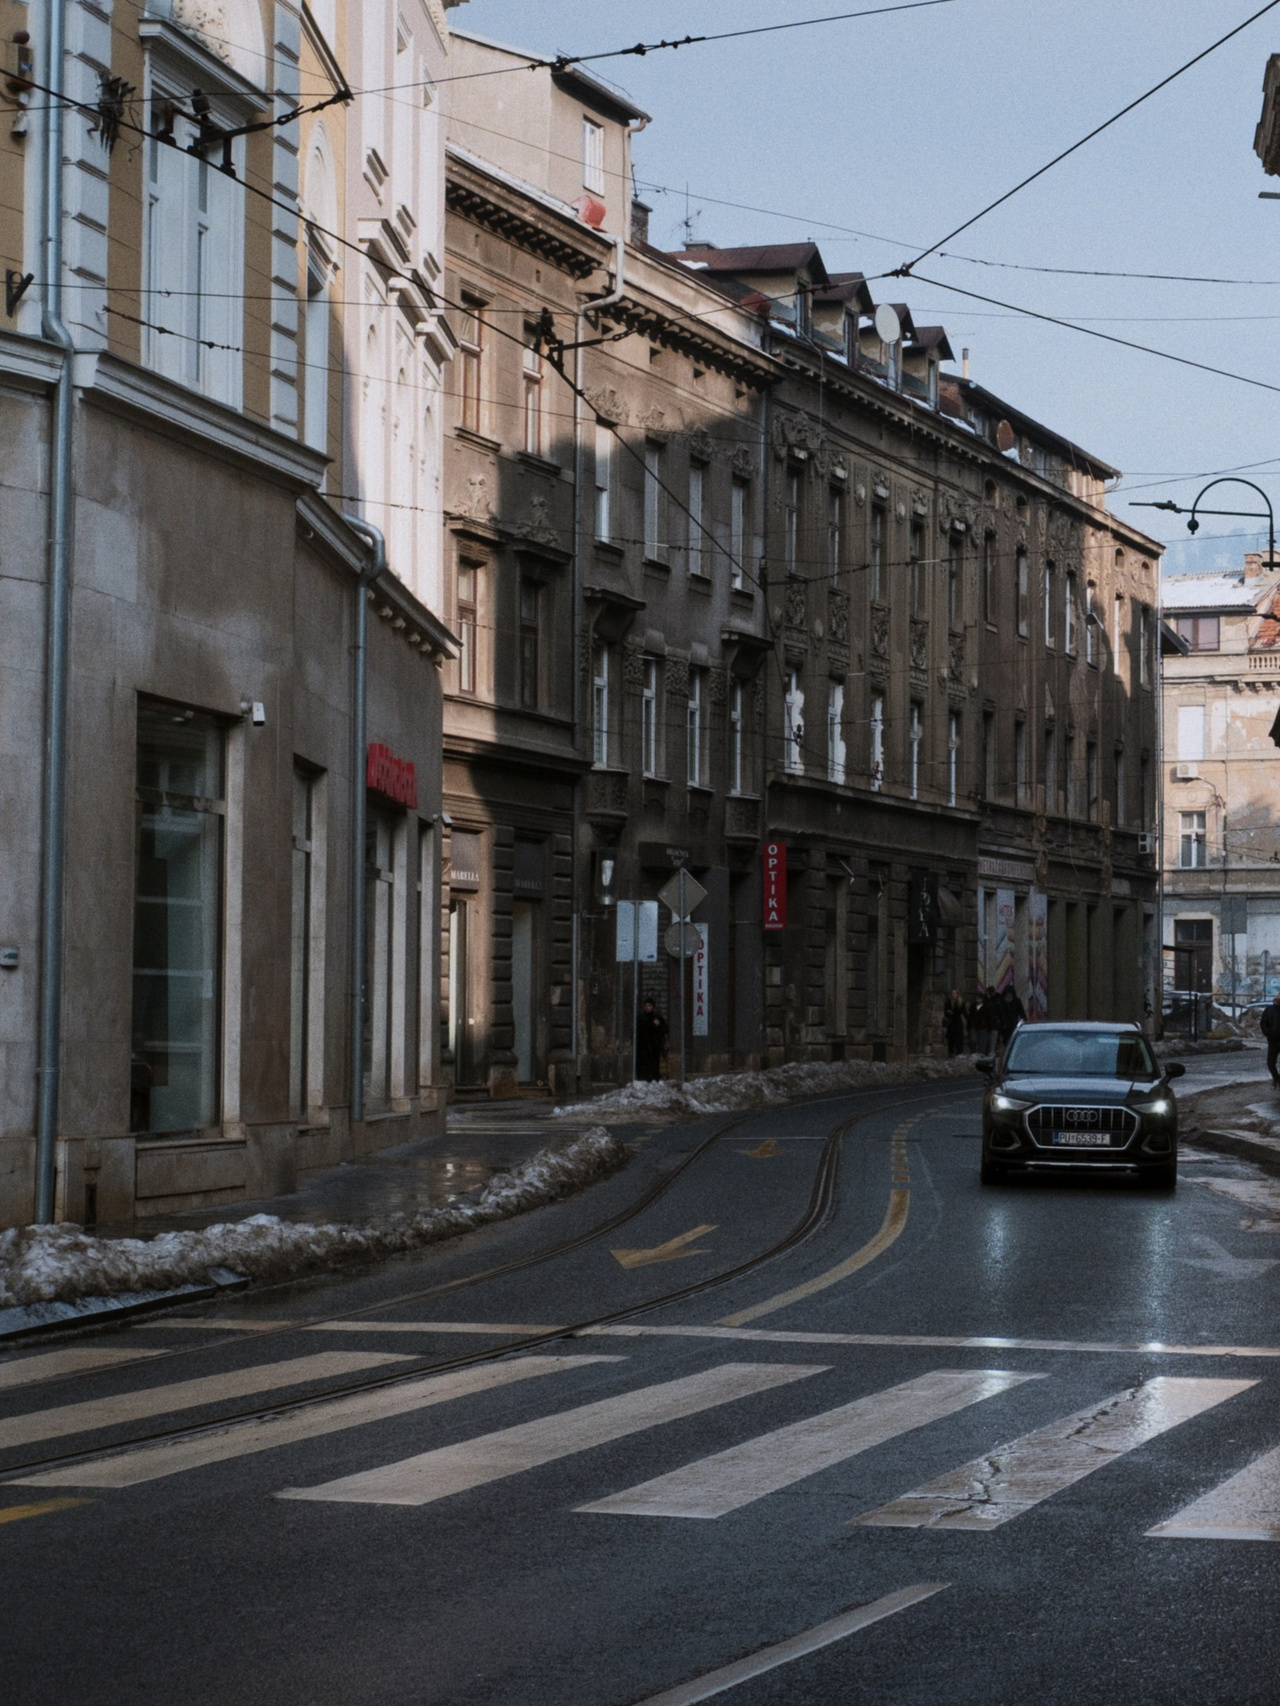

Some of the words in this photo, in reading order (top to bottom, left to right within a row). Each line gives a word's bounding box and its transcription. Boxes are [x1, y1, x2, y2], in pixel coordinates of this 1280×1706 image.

[450, 869, 480, 882] MARELLA
[768, 844, 778, 921] OPTIKA
[1059, 1133, 1071, 1142] PU
